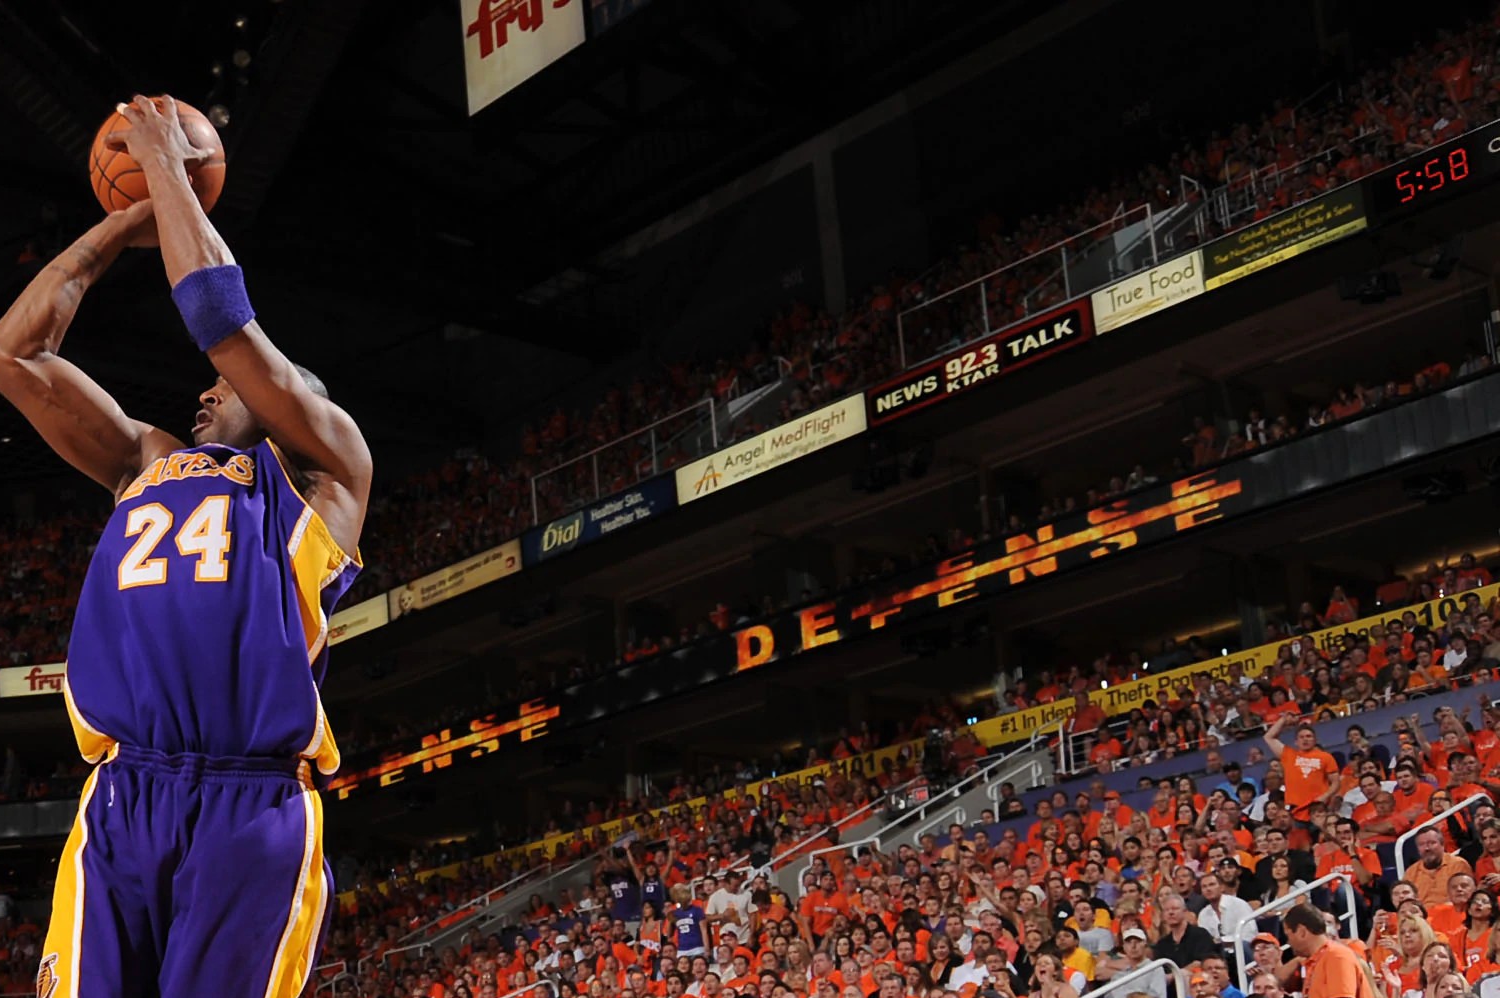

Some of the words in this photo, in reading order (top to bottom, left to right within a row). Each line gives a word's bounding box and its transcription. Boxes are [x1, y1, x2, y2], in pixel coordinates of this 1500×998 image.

[1394, 147, 1469, 203] 5:58
[1107, 286, 1143, 313] True
[1149, 255, 1196, 296] Food
[876, 374, 939, 414] NEWS
[945, 343, 999, 380] 92.3
[1005, 317, 1075, 357] TALK
[946, 362, 1000, 394] KTAR
[724, 443, 765, 471] Angel
[770, 408, 847, 450] MedFlight
[118, 495, 231, 591] 24
[542, 518, 581, 553] Dial
[1000, 716, 1019, 735] #1
[1022, 714, 1037, 730] In
[1106, 683, 1153, 707] Theft
